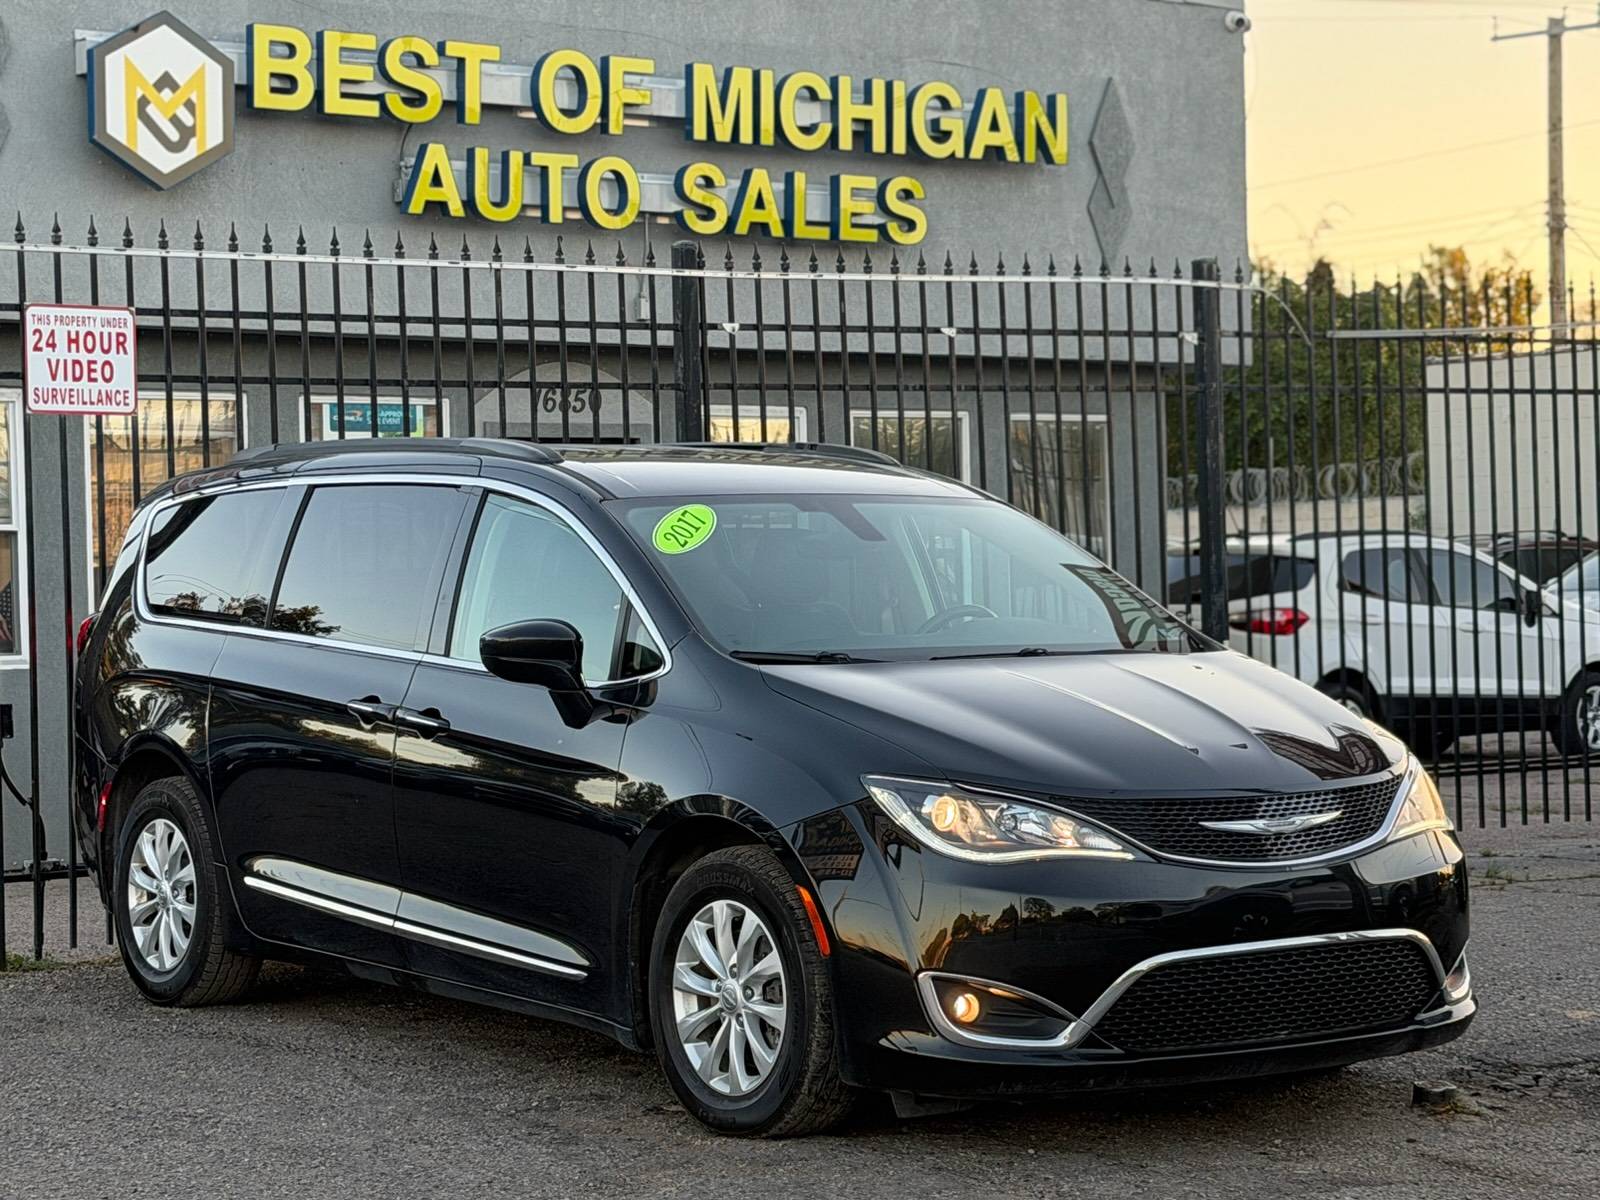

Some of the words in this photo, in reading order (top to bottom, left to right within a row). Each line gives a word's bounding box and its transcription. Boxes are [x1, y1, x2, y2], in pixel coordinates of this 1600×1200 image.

[249, 23, 501, 125] BEST
[534, 49, 655, 135] OF
[688, 62, 1070, 166] MICHIGAN
[405, 142, 641, 230] AUTO
[679, 162, 928, 245] SALES
[31, 313, 51, 326] THIS
[54, 315, 98, 328] PROPERTY
[100, 317, 129, 329] UNDER
[32, 328, 57, 353] 24
[67, 330, 129, 356] HOUR
[47, 358, 115, 384] VIDEO
[33, 387, 130, 407] SURVEILLANCE
[663, 509, 707, 548] 2017
